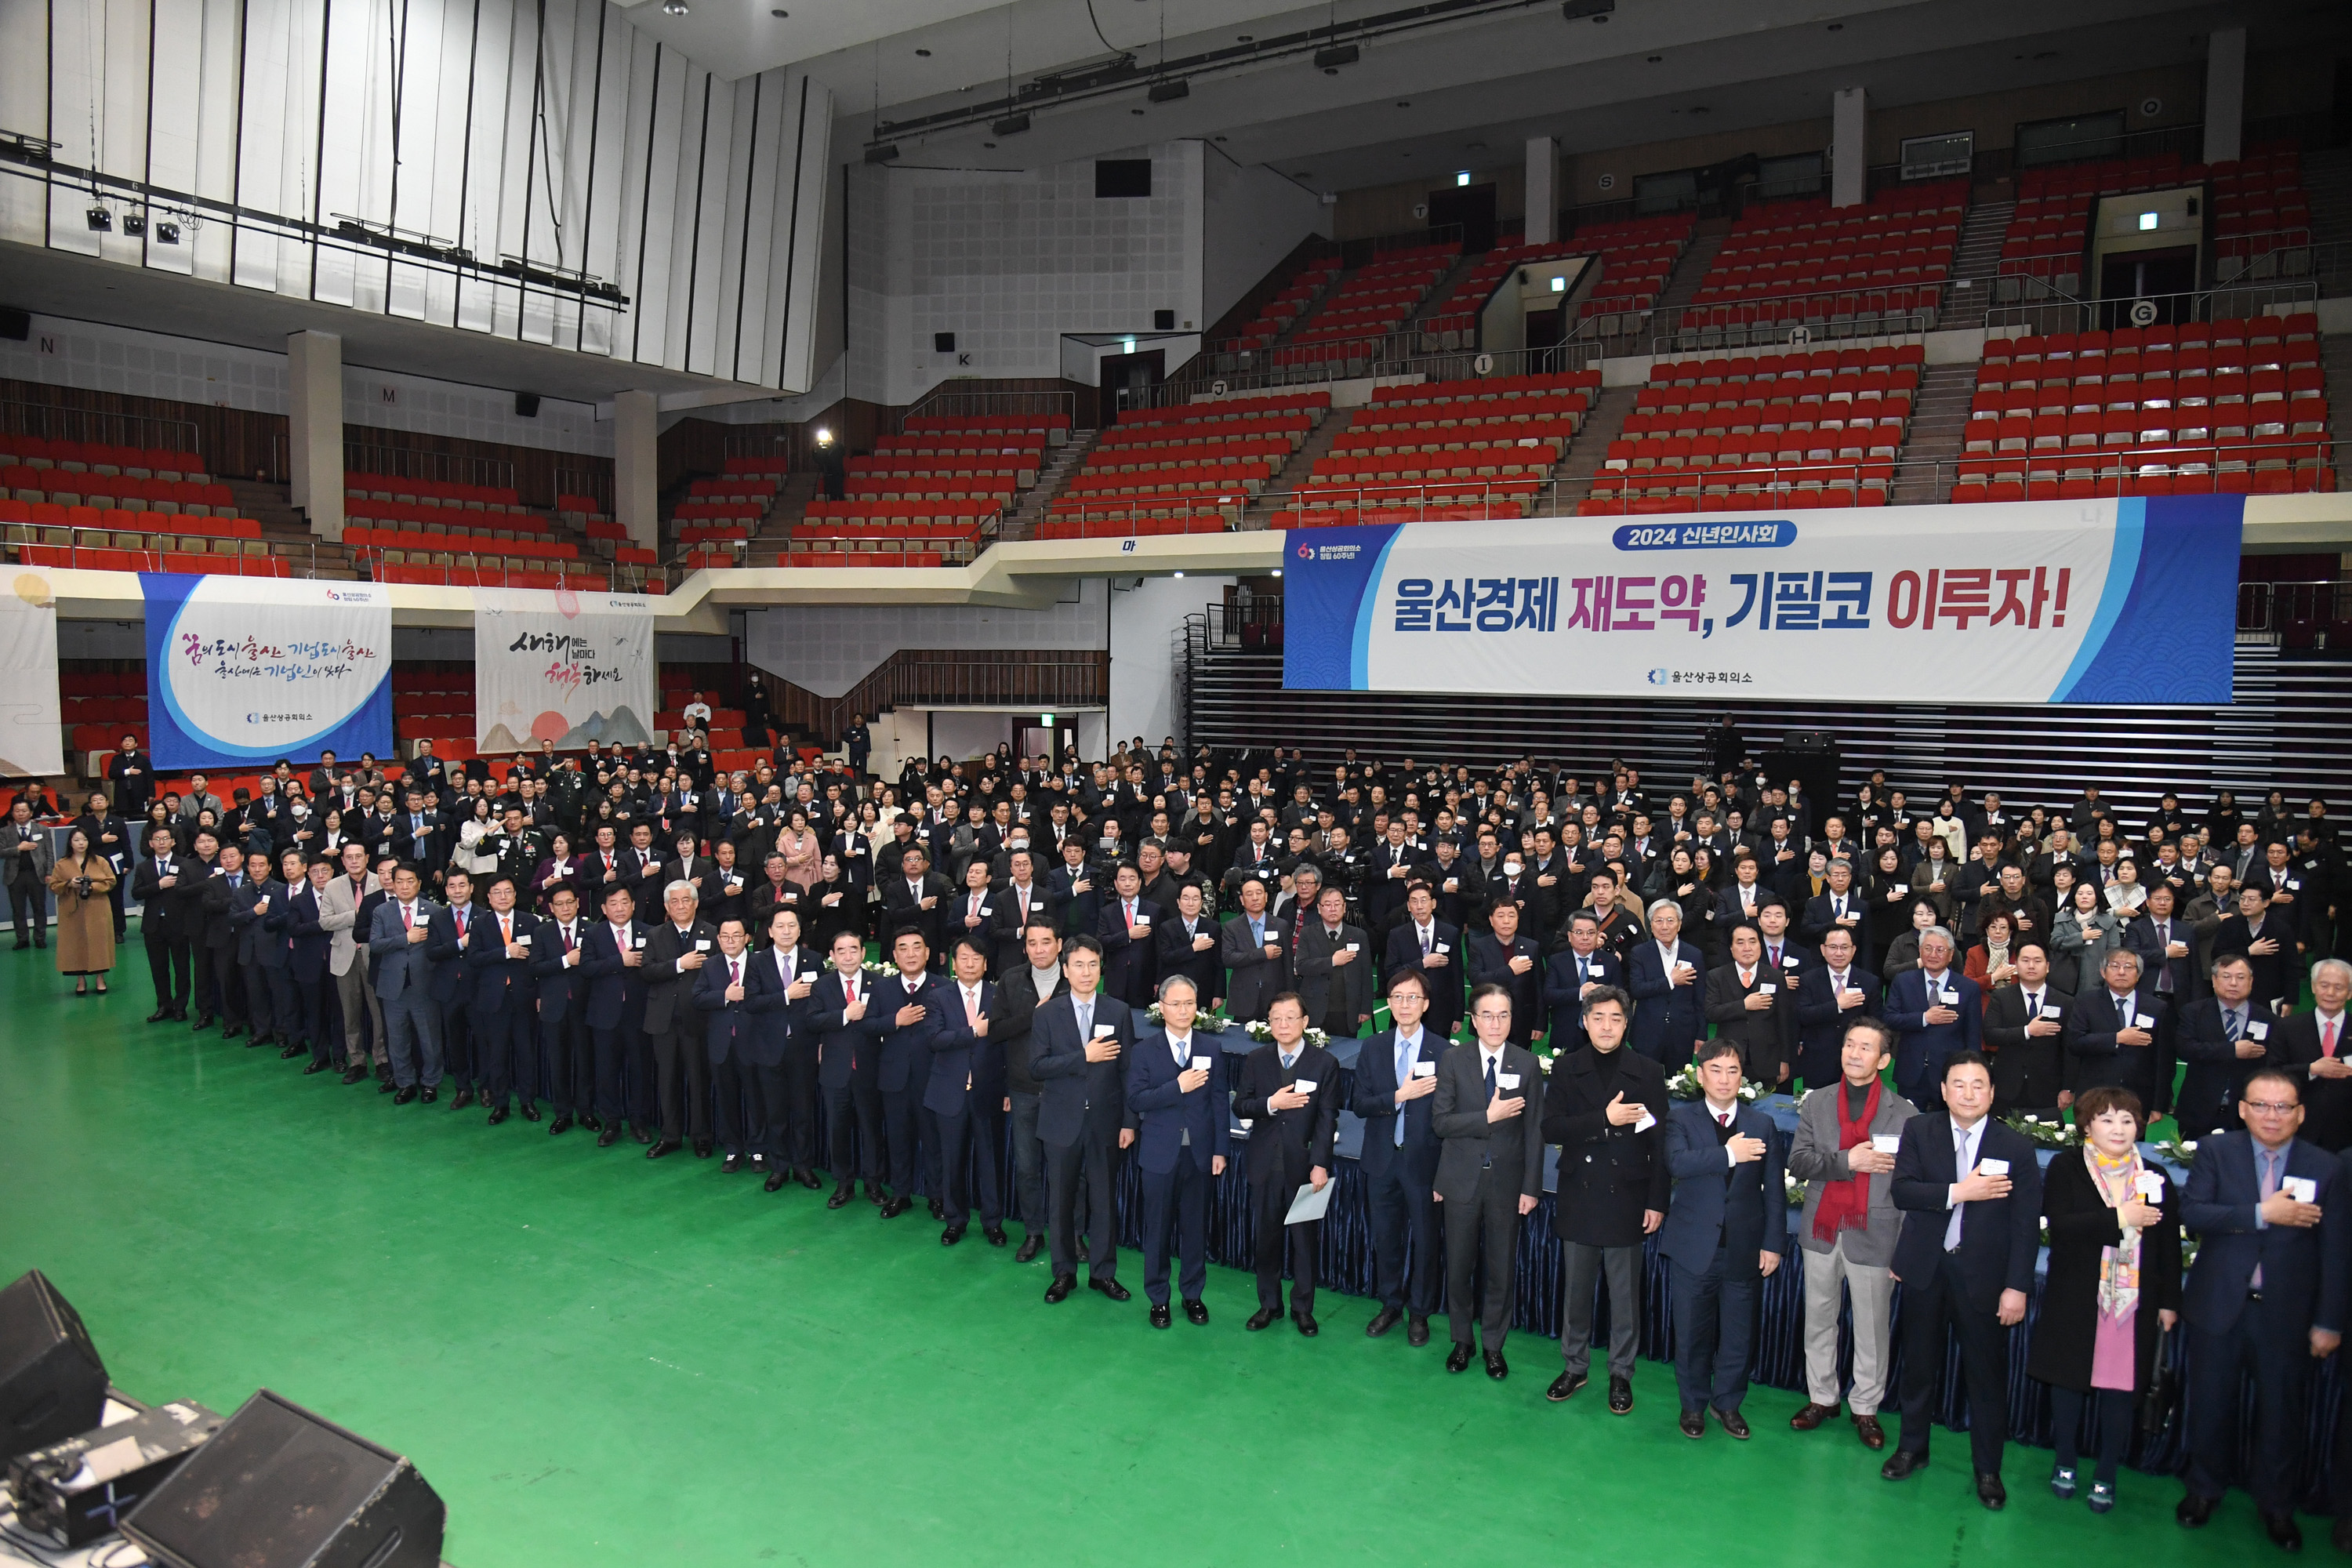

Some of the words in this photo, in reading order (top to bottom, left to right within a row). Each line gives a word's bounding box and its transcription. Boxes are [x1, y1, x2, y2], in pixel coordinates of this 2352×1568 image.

[2144, 101, 2158, 114] Q
[132, 181, 139, 191] 6
[1601, 176, 1612, 187] S
[192, 196, 198, 205] 9
[1416, 206, 1425, 217] T
[367, 237, 372, 245] 3
[402, 245, 408, 254] 2
[441, 254, 447, 263] 5
[581, 287, 586, 296] 2
[2135, 305, 2152, 321] G
[1792, 330, 1807, 345] H
[41, 337, 53, 354] N
[960, 354, 971, 365] K
[1480, 358, 1486, 372] I
[383, 388, 395, 403] M
[1214, 383, 1225, 396] J
[1628, 528, 1677, 546] 2024
[1682, 524, 1779, 545] 신년인사회
[1123, 540, 1137, 552] 마
[1394, 576, 1559, 633] 울산경제
[1566, 573, 1714, 639] 재도약,
[1726, 570, 1874, 630] 기필코
[1886, 565, 2071, 630] 이루자!
[241, 635, 285, 662] 울산
[342, 639, 377, 661] 울산
[572, 649, 595, 659] 날마다
[1671, 670, 1753, 684] 울산상공회의소
[262, 713, 314, 722] 울산상공회의소
